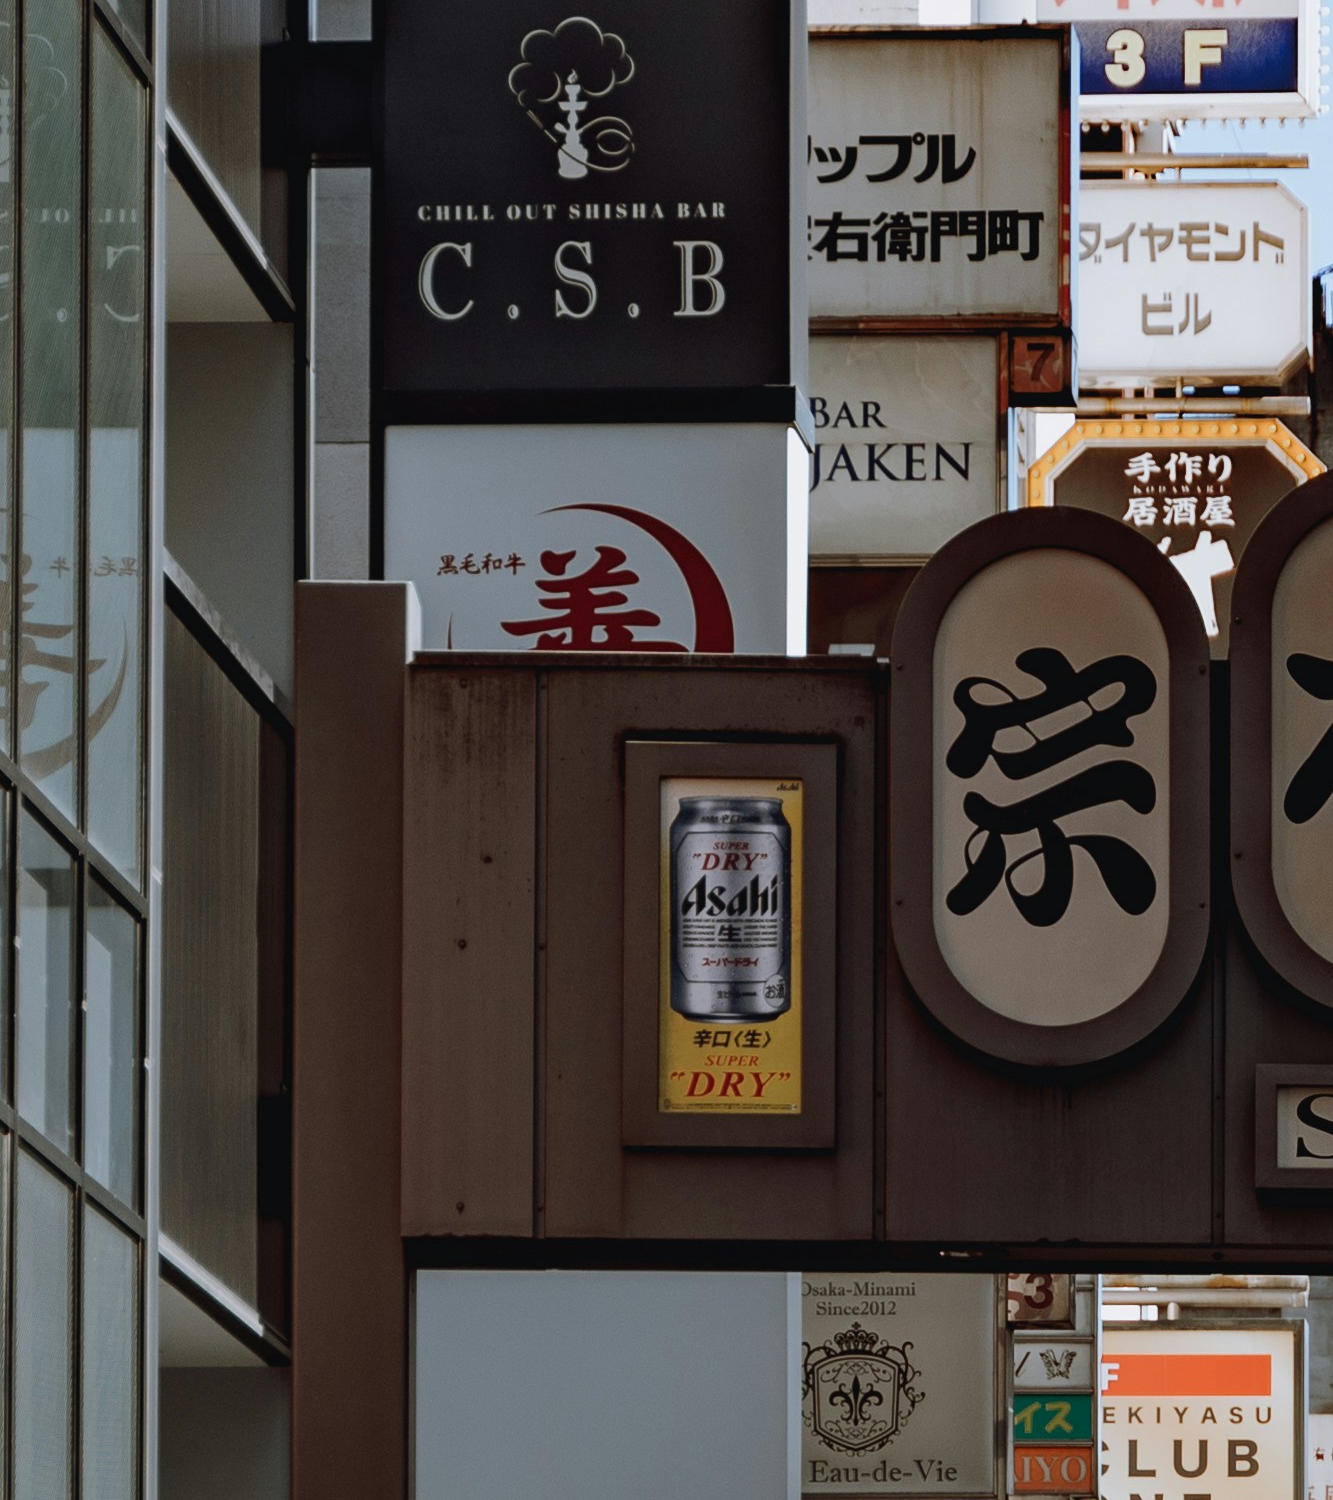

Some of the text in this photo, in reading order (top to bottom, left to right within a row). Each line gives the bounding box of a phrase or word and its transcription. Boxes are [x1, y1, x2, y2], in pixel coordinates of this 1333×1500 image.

[808, 132, 977, 184] ップル
[418, 202, 727, 221] CHILL OUT SHISHA BAR
[808, 210, 1044, 263] 右衛門町
[1078, 219, 1285, 264] ダイヤモンド
[1140, 292, 1212, 336] ビル
[1026, 342, 1057, 381] 7
[810, 397, 888, 429] BAR
[1123, 451, 1233, 484] 手作り
[1122, 496, 1236, 526] 居酒屋
[437, 553, 527, 576] 黒毛和牛
[712, 841, 749, 851] SUPER
[681, 874, 779, 917] Asahi
[717, 924, 742, 942] 生
[702, 955, 759, 967] スーパードライ
[704, 1055, 759, 1067] SUPER
[801, 1281, 917, 1298] Osaka-Minami
[1024, 1273, 1054, 1311] 3
[815, 1301, 897, 1316] Since2012
[808, 1459, 958, 1484] Eau-de-Vie
